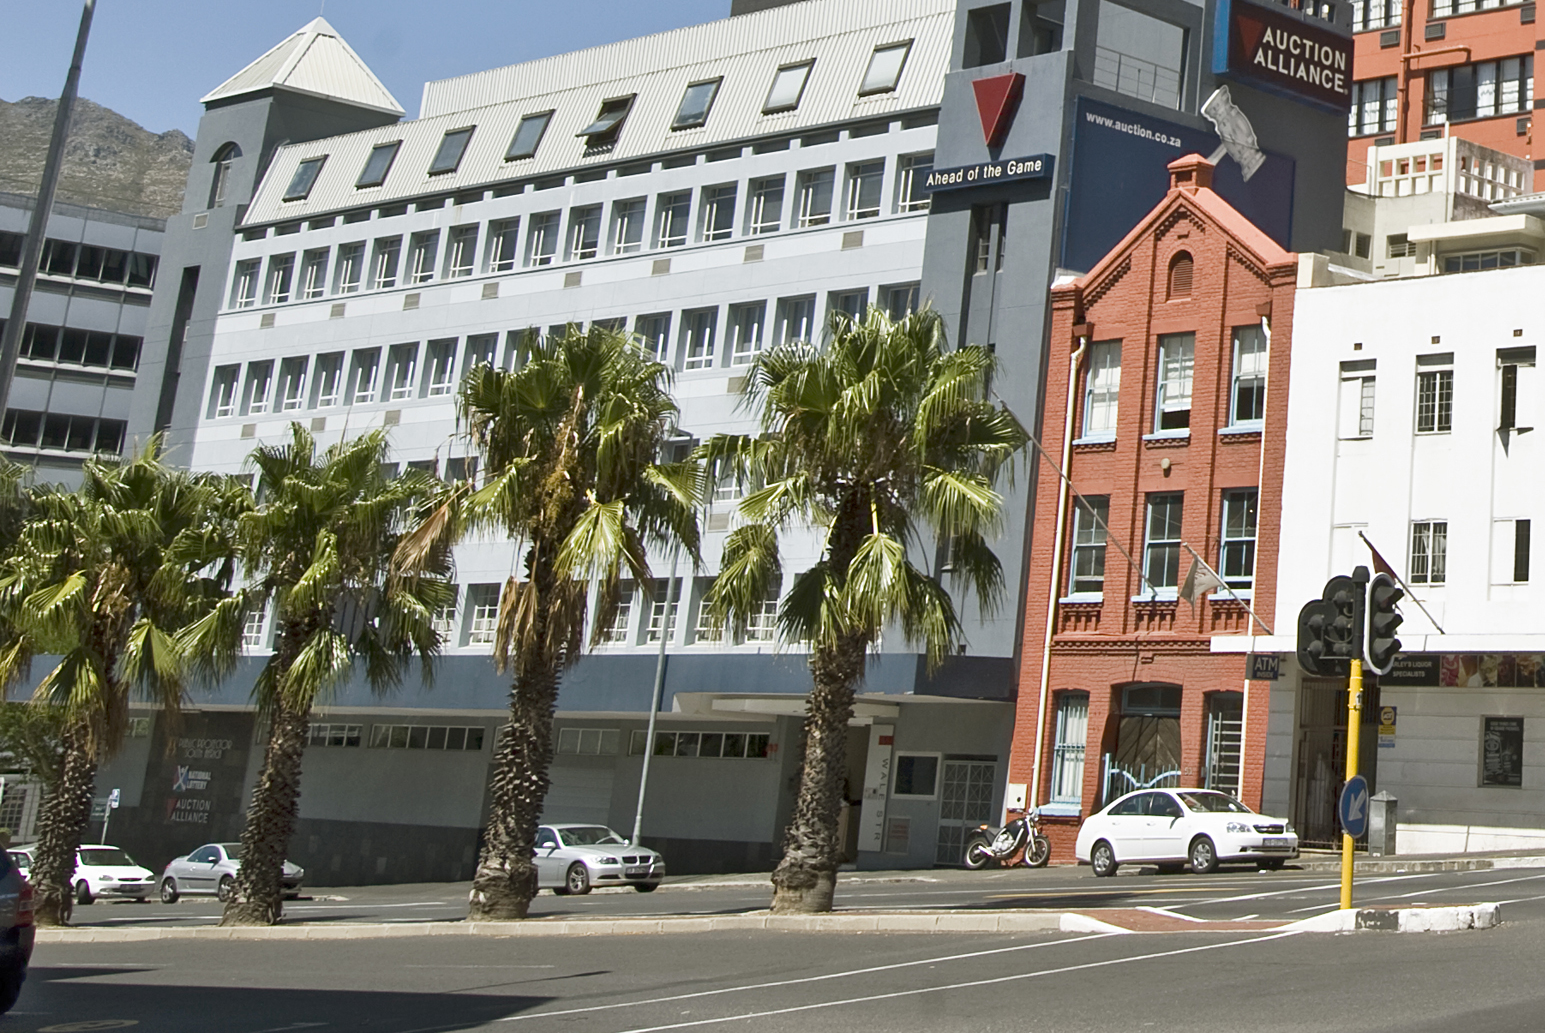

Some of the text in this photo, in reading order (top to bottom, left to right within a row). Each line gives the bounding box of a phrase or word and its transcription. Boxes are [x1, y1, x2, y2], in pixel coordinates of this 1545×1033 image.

[1262, 26, 1346, 71] AUCTION
[1253, 46, 1345, 94] ALLIANCE
[1085, 112, 1182, 148] www.auction.co.za
[925, 159, 1042, 187] Ahead of the Game
[1254, 654, 1278, 672] ATM
[1256, 671, 1274, 679] INSIDE
[1392, 670, 1426, 678] SPECIALISTS
[188, 770, 212, 781] NATIONAL
[186, 780, 208, 790] LOTTERY
[175, 798, 212, 811] AUCTION
[874, 758, 889, 841] WALE STR
[170, 810, 209, 824] ALLIANCE
